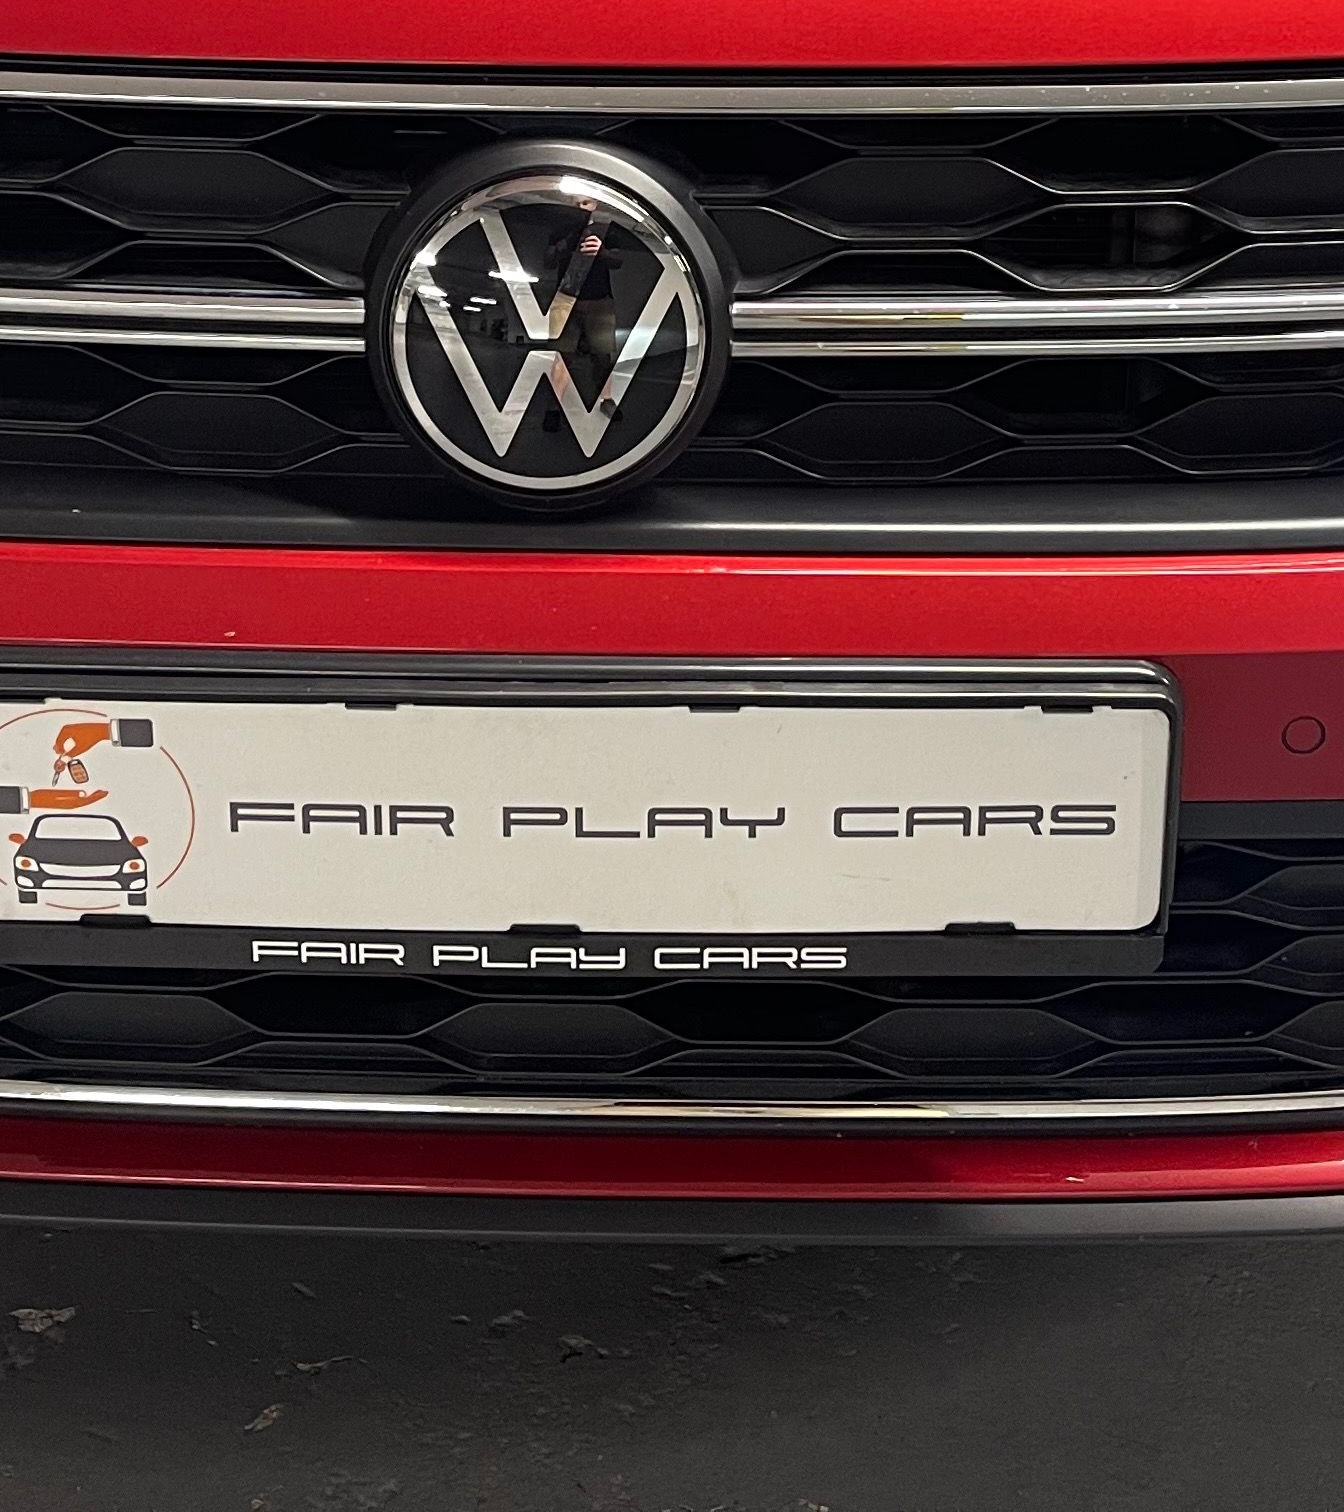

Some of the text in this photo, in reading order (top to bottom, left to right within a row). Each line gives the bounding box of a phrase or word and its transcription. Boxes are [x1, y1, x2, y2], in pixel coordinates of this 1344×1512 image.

[404, 194, 692, 460] VW
[229, 801, 1117, 839] FAIR PLAY CARS
[252, 940, 848, 970] FAIR PLAY CARS
